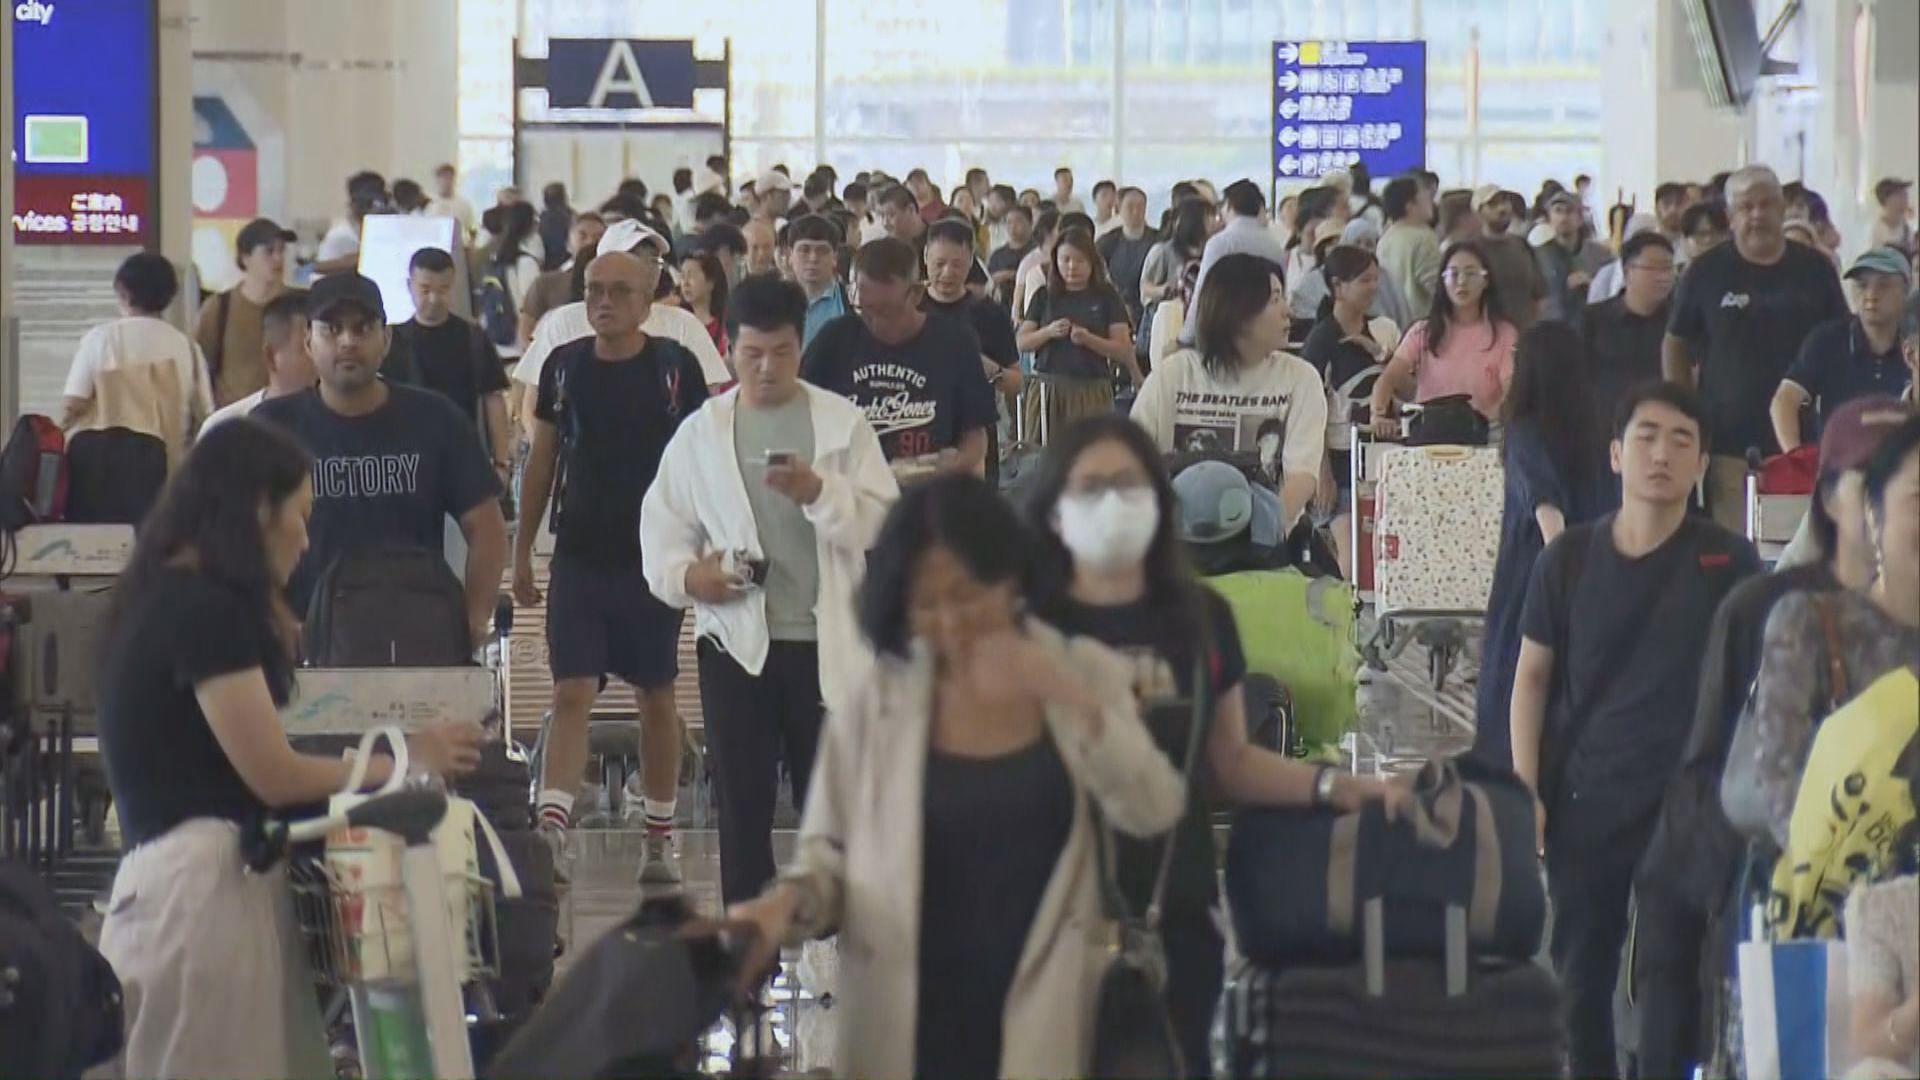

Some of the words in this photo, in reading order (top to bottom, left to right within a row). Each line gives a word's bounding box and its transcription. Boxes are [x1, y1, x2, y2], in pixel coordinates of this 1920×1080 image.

[16, 0, 54, 25] city
[587, 39, 655, 108] A
[853, 364, 927, 390] AUTHENTIC
[1175, 392, 1200, 404] THE
[1261, 394, 1293, 408] BAN
[313, 453, 420, 498] ICTORY
